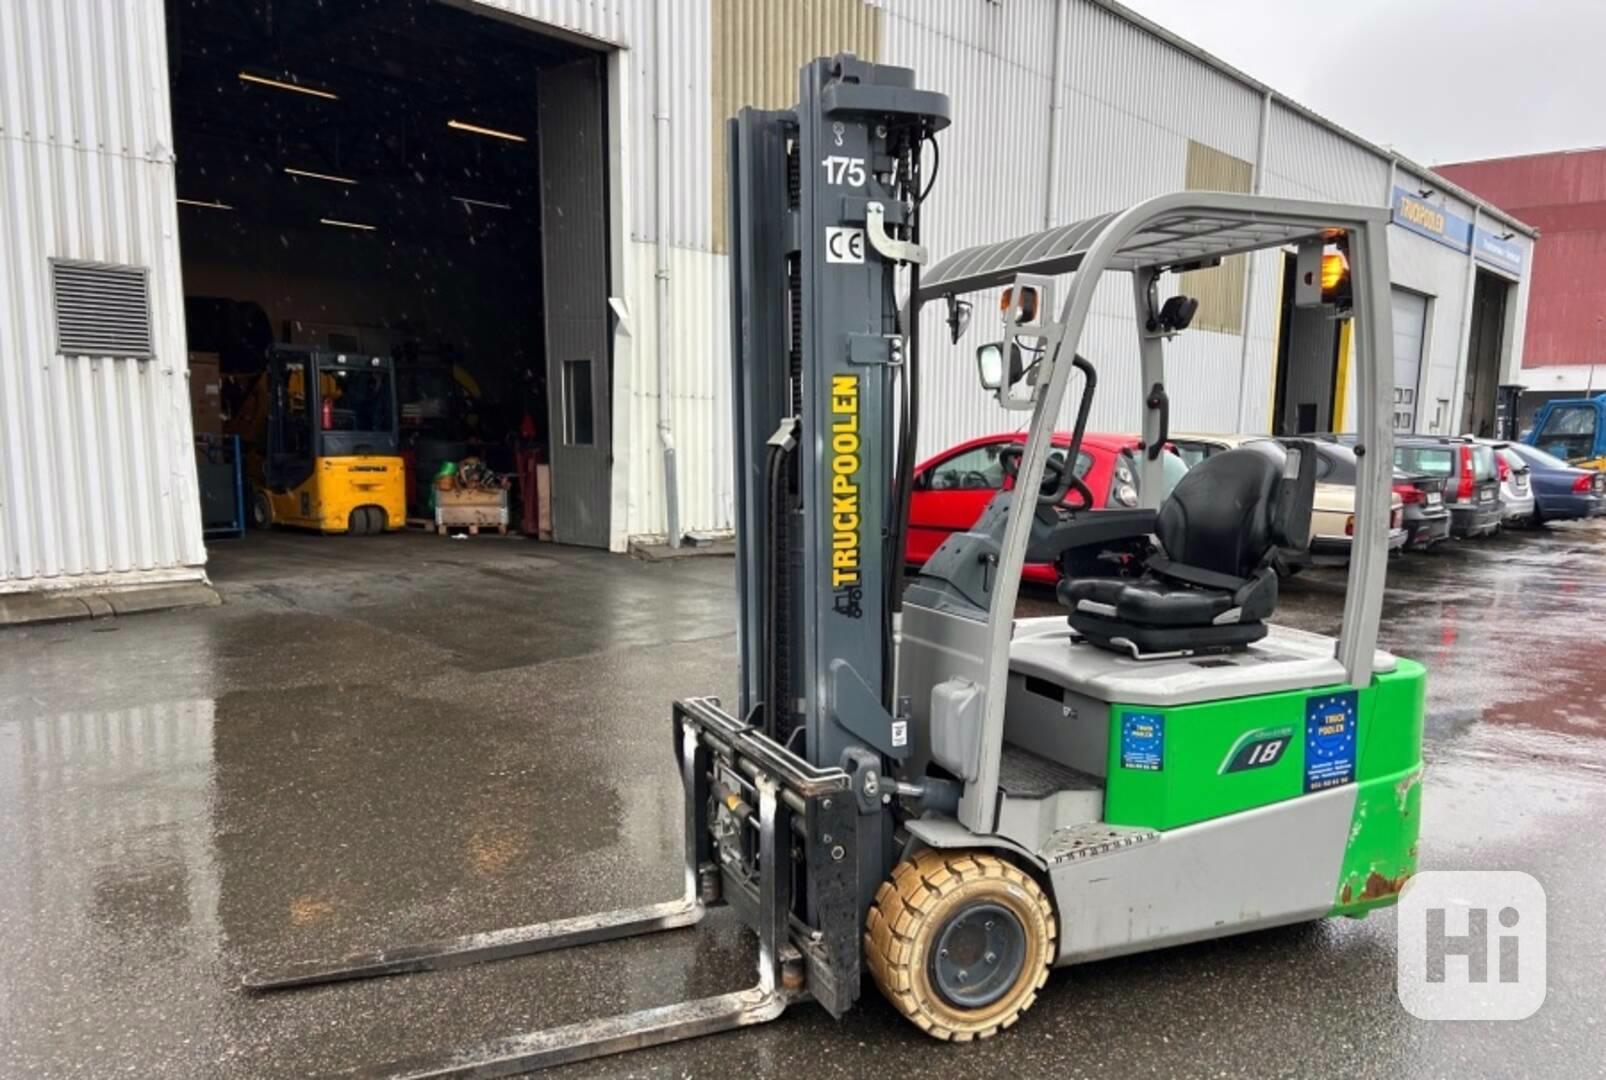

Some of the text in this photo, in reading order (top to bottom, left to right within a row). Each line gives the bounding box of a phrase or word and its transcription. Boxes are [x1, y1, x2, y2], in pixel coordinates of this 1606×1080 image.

[822, 155, 866, 187] 175
[829, 231, 862, 259] CE
[832, 375, 860, 587] TRUCKPOOLEN
[1247, 740, 1282, 765] 18
